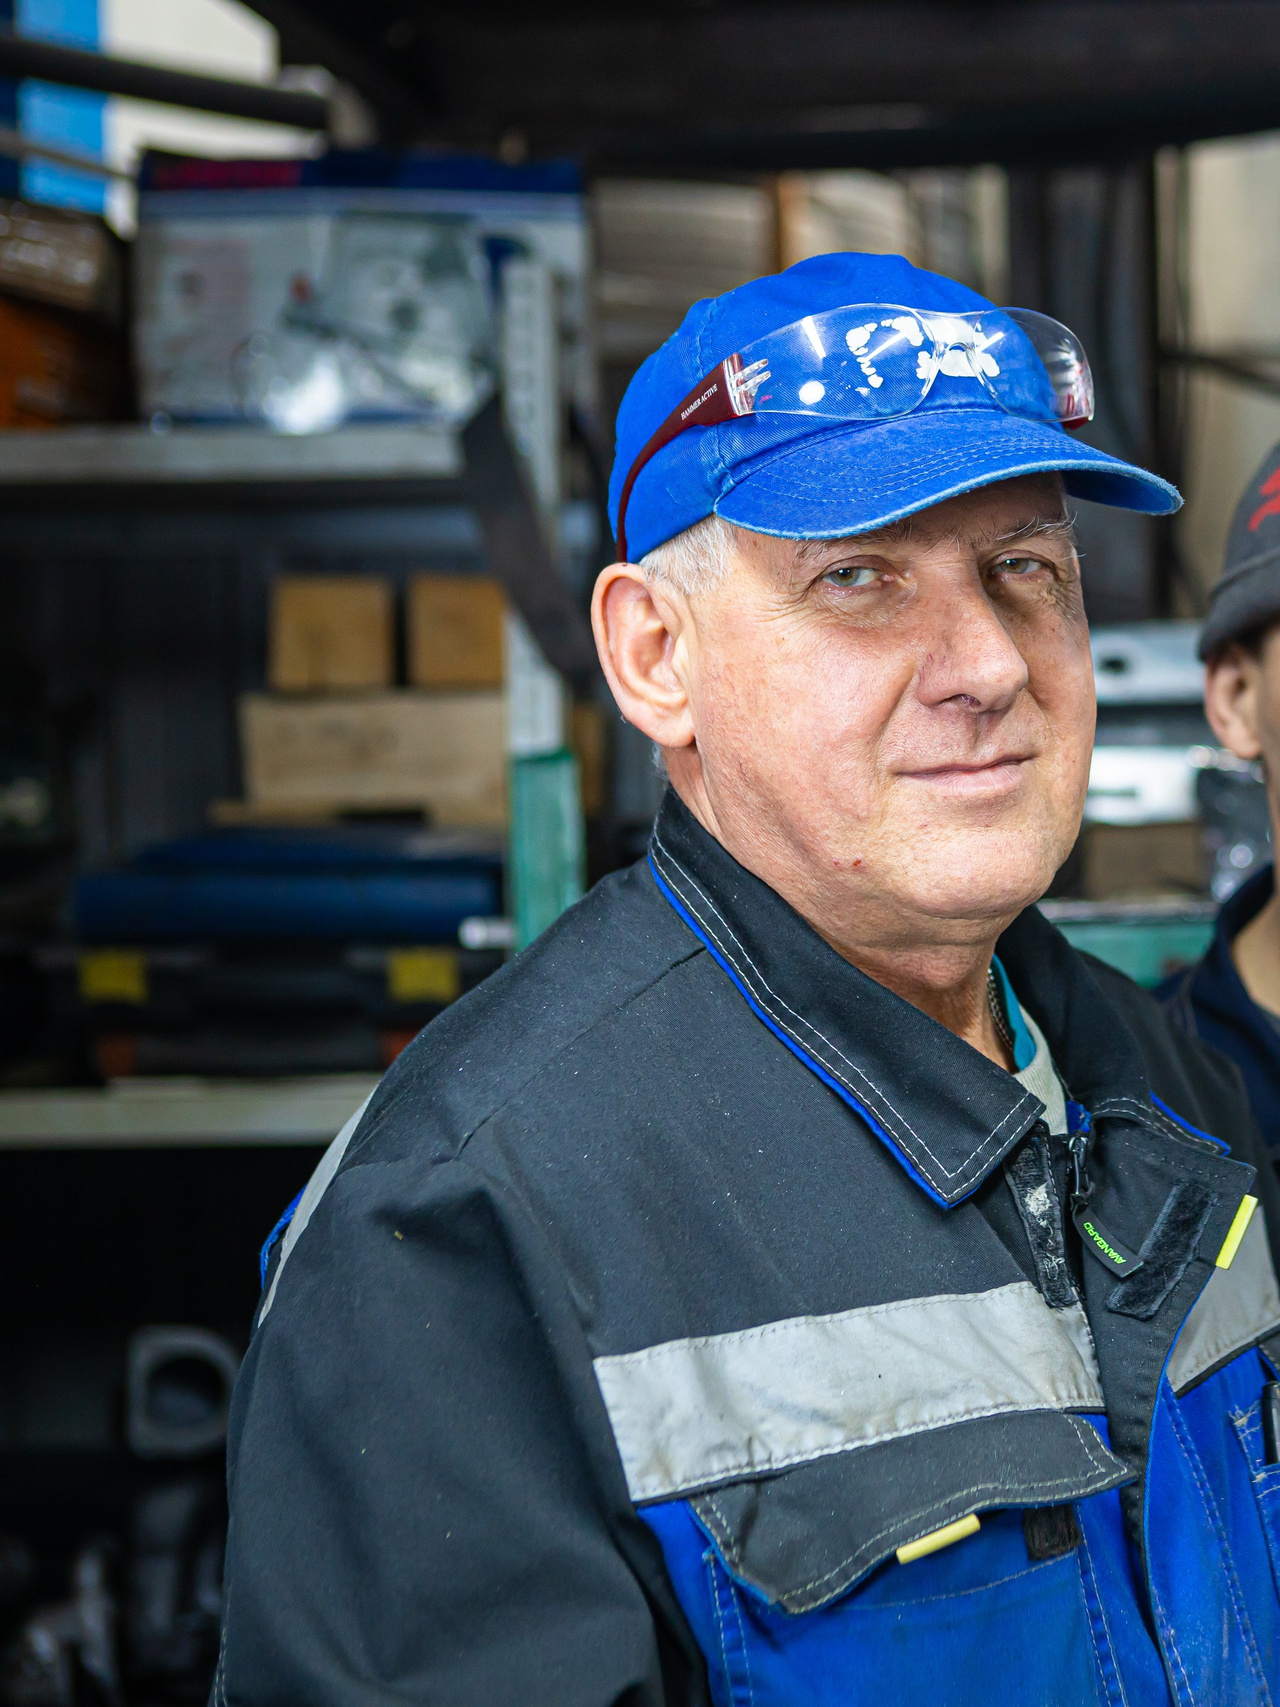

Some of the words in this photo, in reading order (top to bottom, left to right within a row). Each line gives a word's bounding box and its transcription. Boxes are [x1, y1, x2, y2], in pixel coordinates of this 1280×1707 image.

[680, 398, 702, 421] HAMMER
[701, 383, 718, 404] ACTIVE
[1083, 1221, 1128, 1265] AVANGARD
